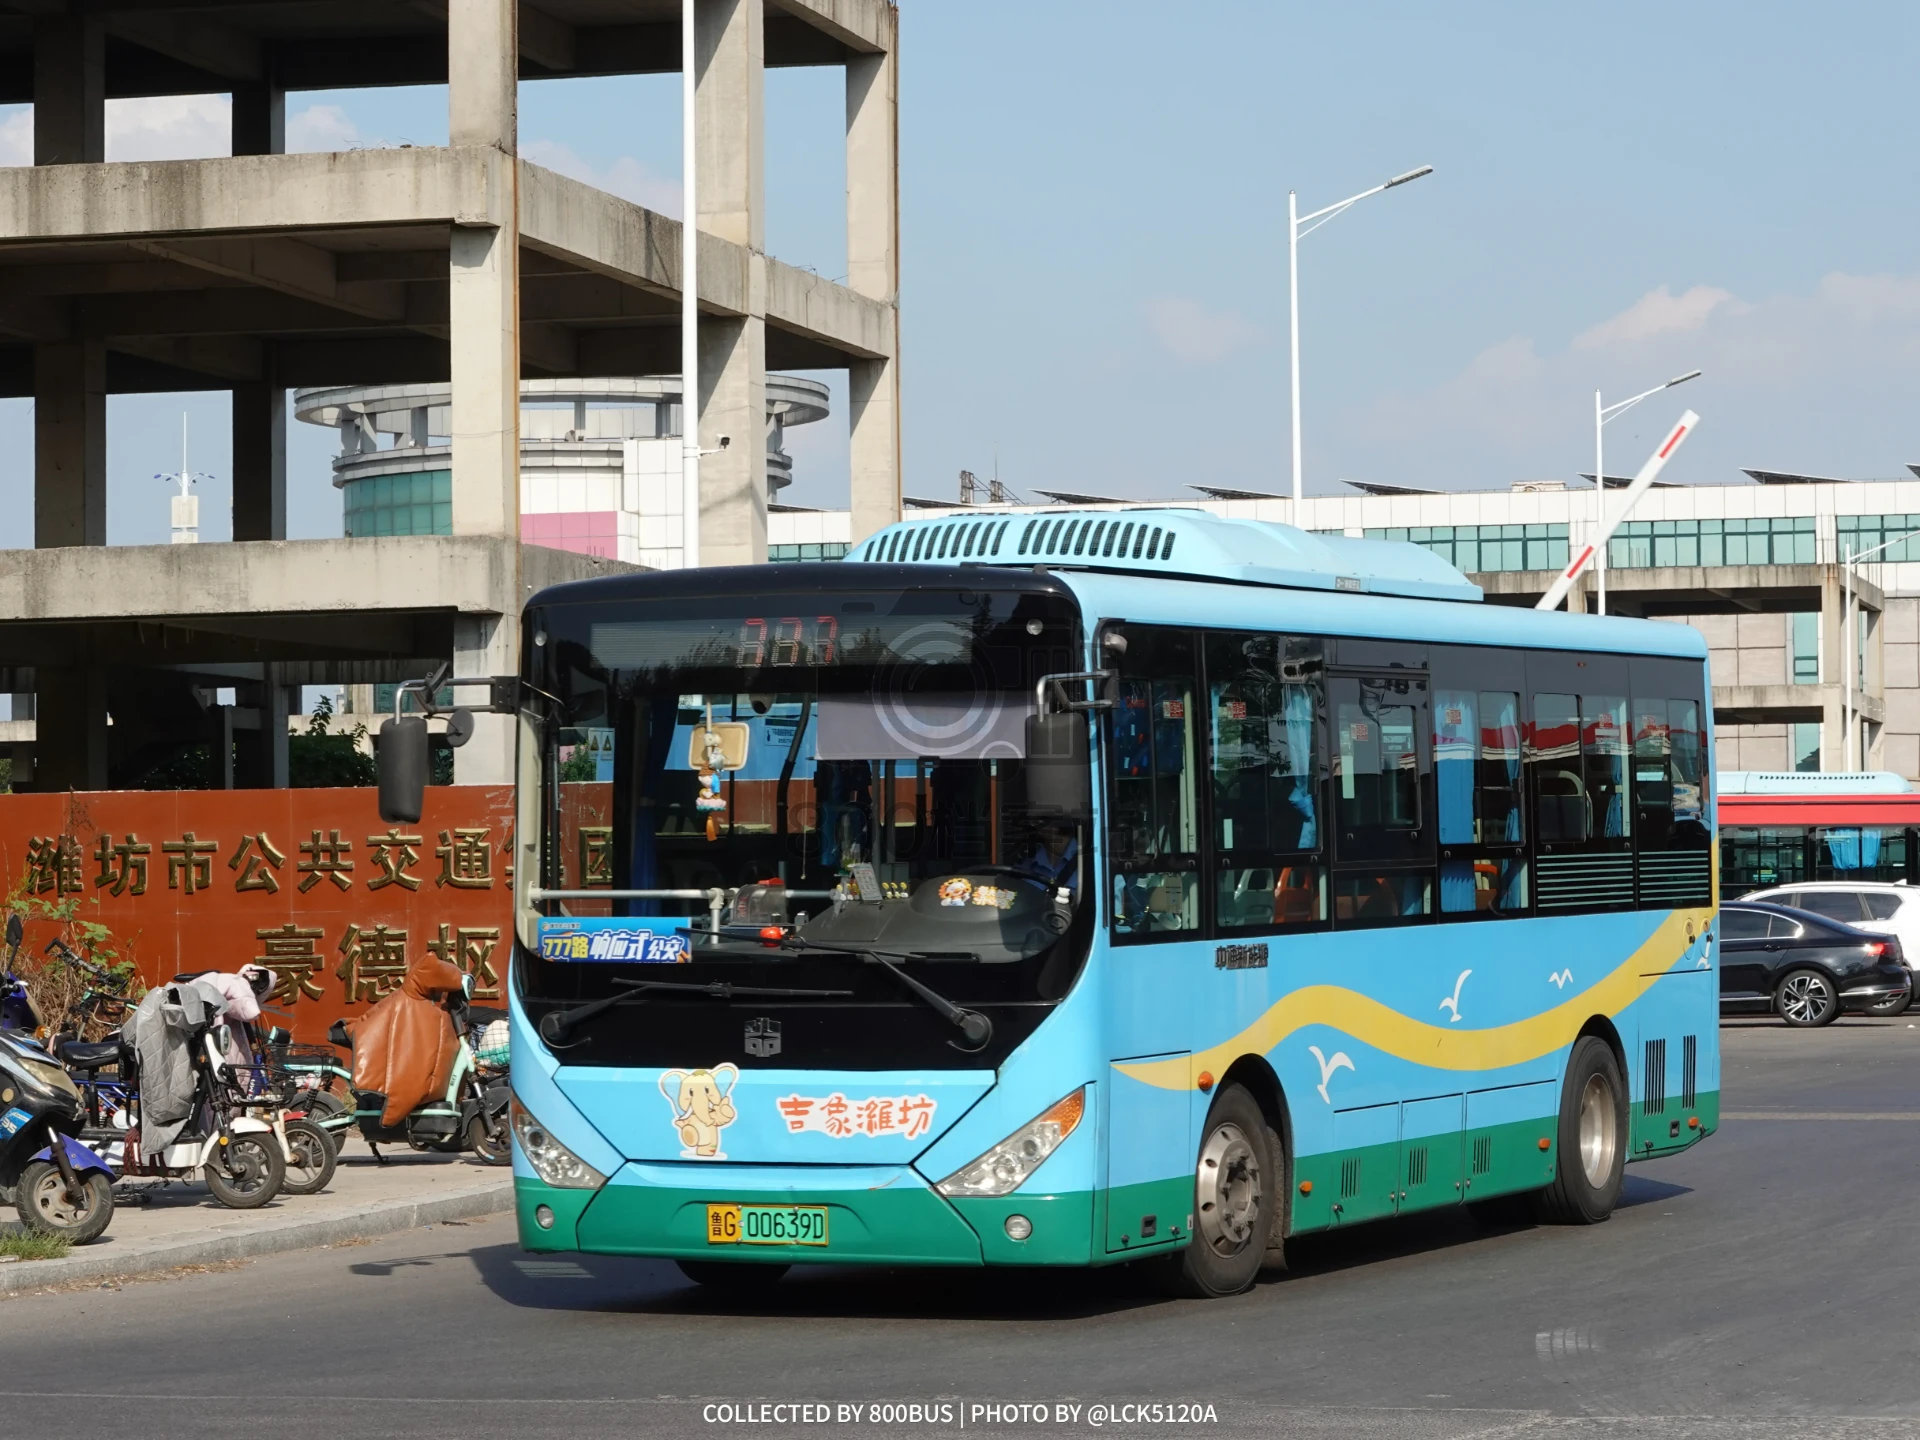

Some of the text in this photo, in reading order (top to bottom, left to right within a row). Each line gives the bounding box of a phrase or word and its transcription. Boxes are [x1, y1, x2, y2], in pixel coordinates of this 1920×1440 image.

[738, 615, 838, 667] 777
[25, 825, 613, 896] 潍坊市公共交通团
